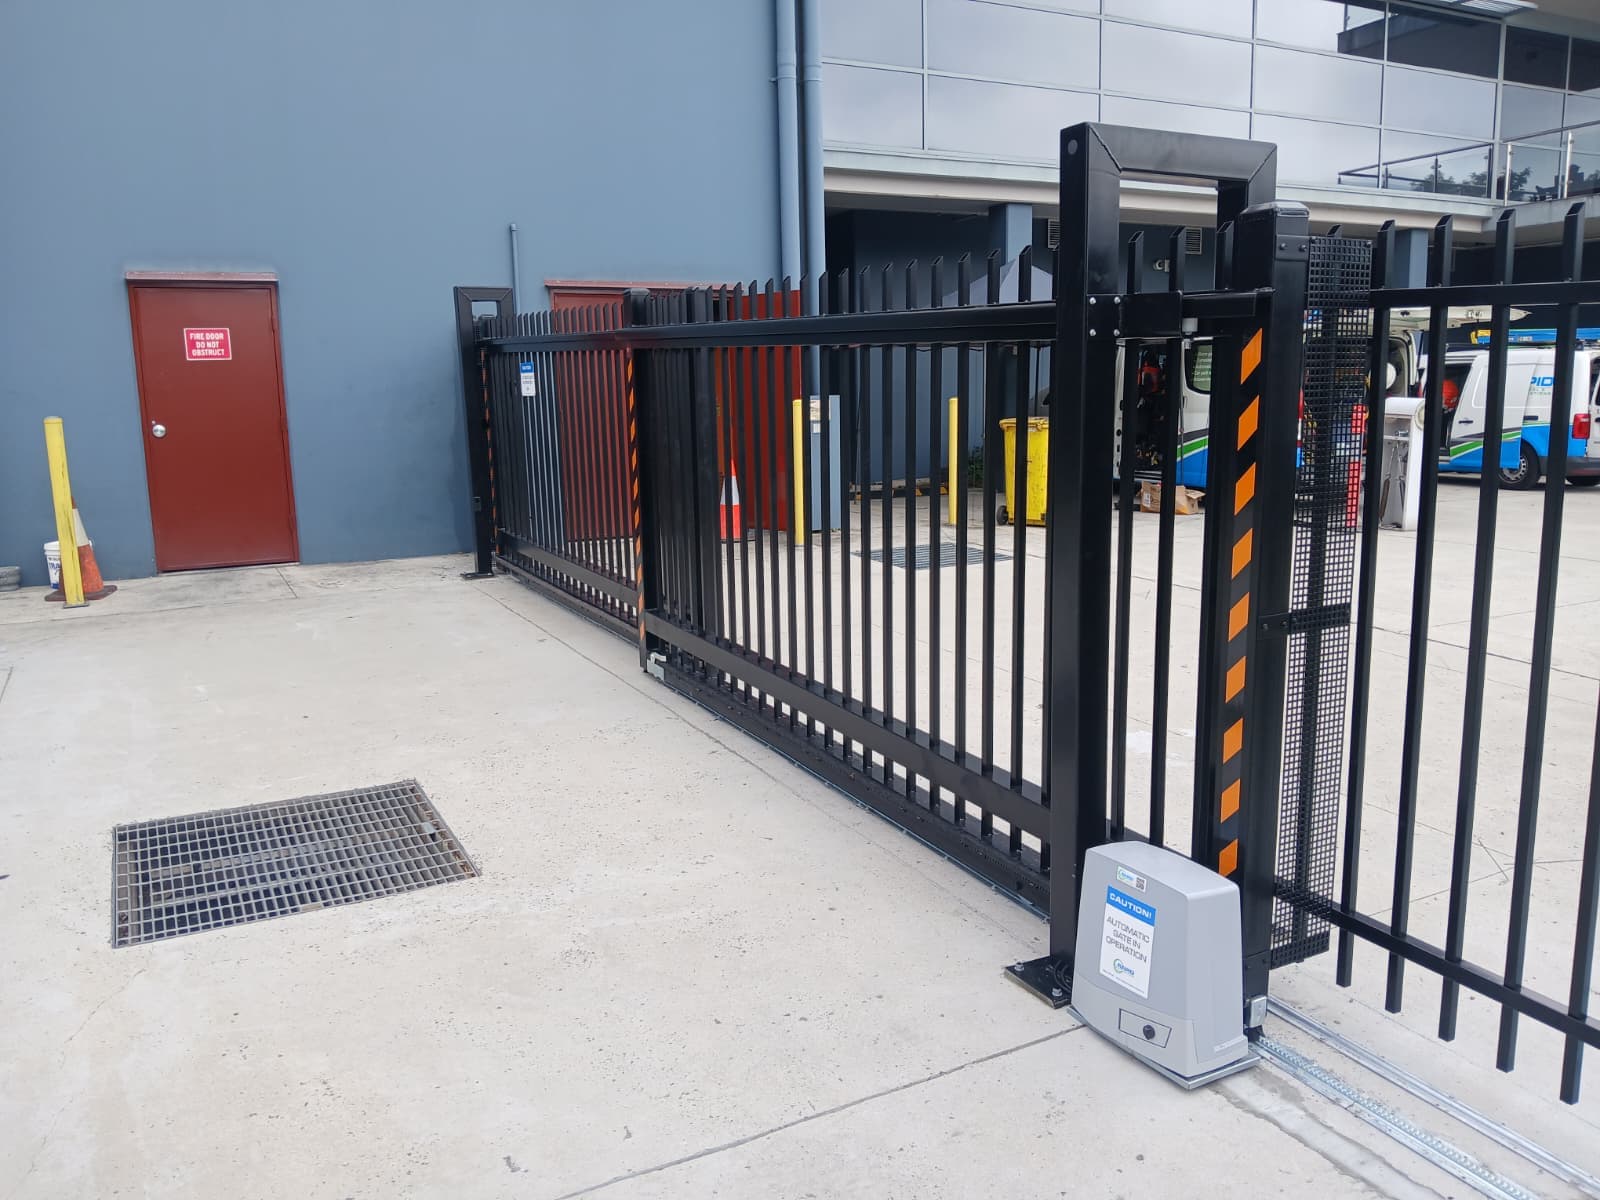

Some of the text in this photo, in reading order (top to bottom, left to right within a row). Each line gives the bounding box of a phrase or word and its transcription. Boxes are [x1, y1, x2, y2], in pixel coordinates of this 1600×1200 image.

[1109, 892, 1152, 919] CAUTION!
[1106, 916, 1150, 943] AUTOMATIC
[1112, 930, 1141, 950] GATE IN
[1105, 936, 1147, 963] OPERATION
